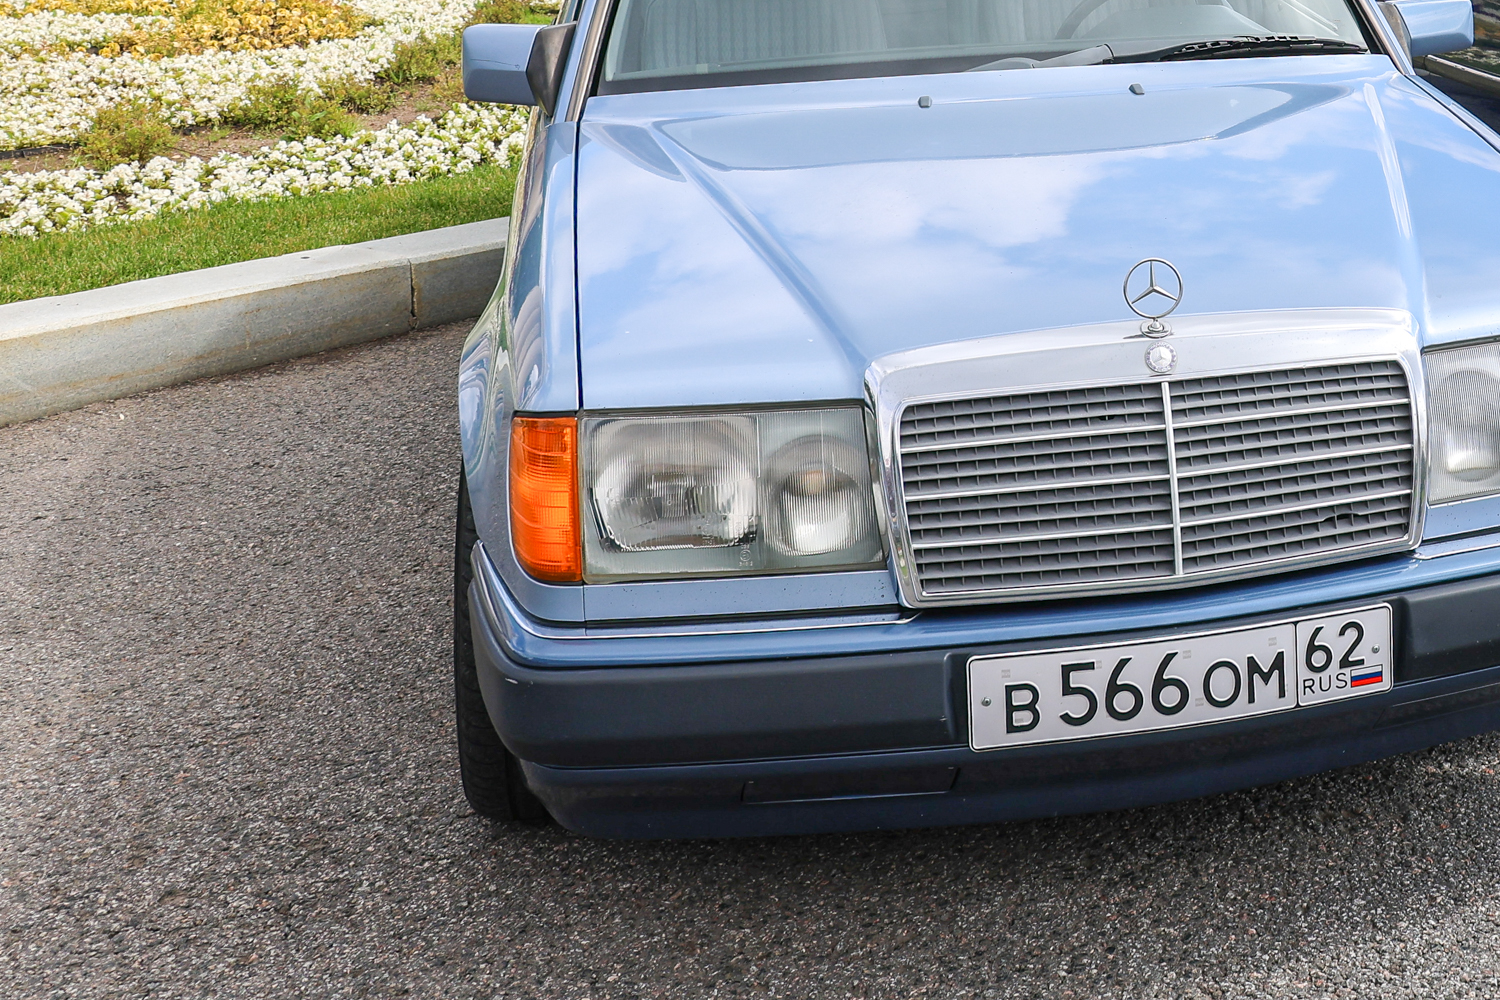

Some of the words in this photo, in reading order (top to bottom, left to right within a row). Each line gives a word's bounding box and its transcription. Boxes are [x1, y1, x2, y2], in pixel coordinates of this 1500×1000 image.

[1004, 651, 1286, 735] В566ОМ
[1304, 621, 1365, 673] 62
[1303, 672, 1348, 696] RUS
